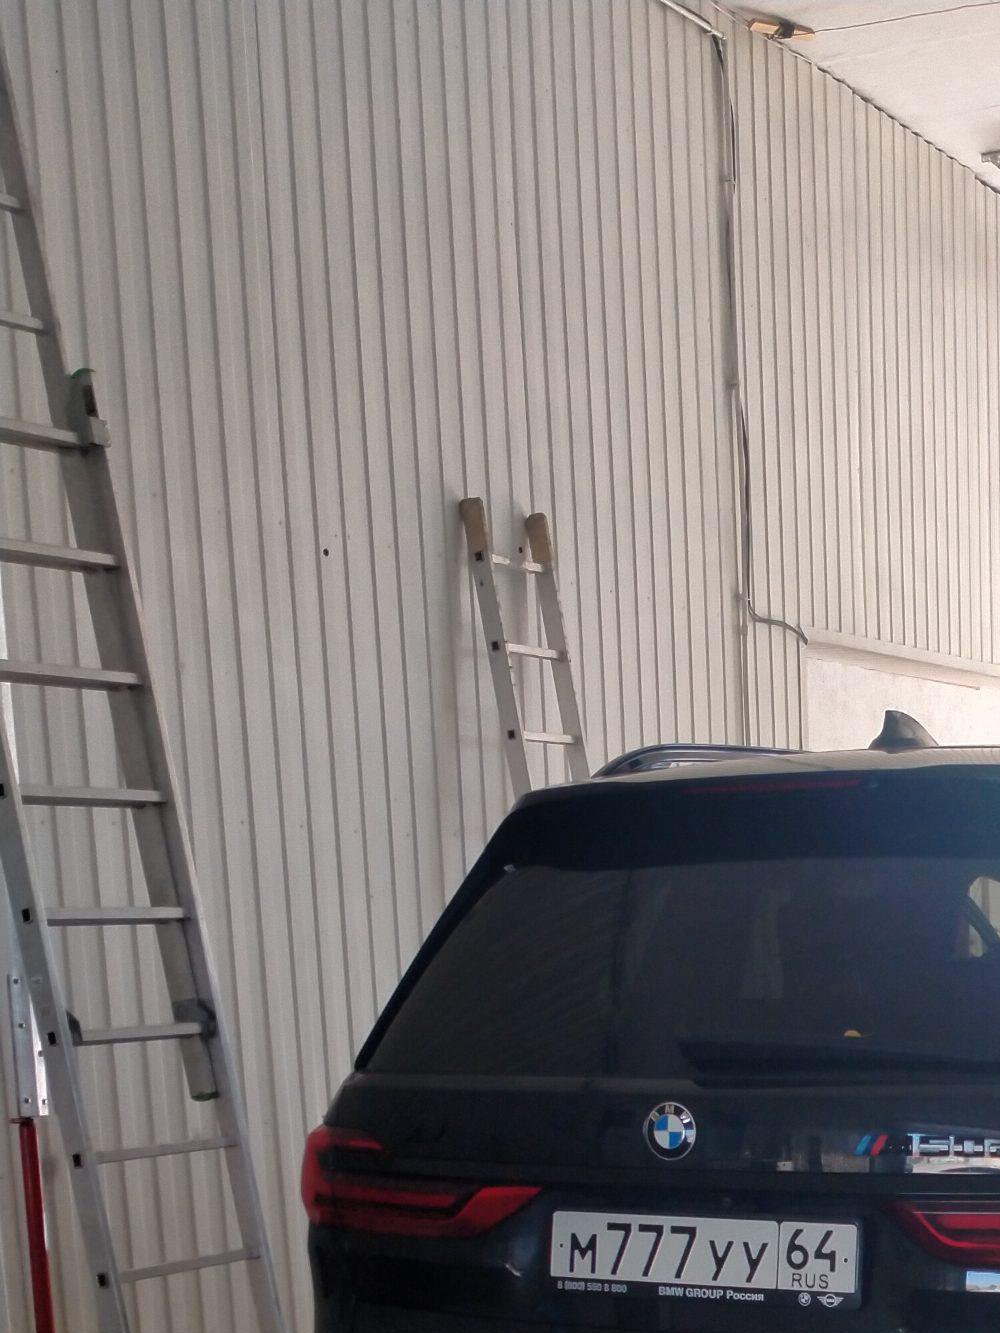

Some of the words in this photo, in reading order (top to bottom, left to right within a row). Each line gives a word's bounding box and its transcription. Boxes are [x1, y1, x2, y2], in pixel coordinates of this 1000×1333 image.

[785, 1229, 837, 1273] 64
[791, 1272, 829, 1289] RUS
[658, 1286, 684, 1297] BMW
[685, 1288, 723, 1299] GROUP
[726, 1290, 764, 1301] Россия
